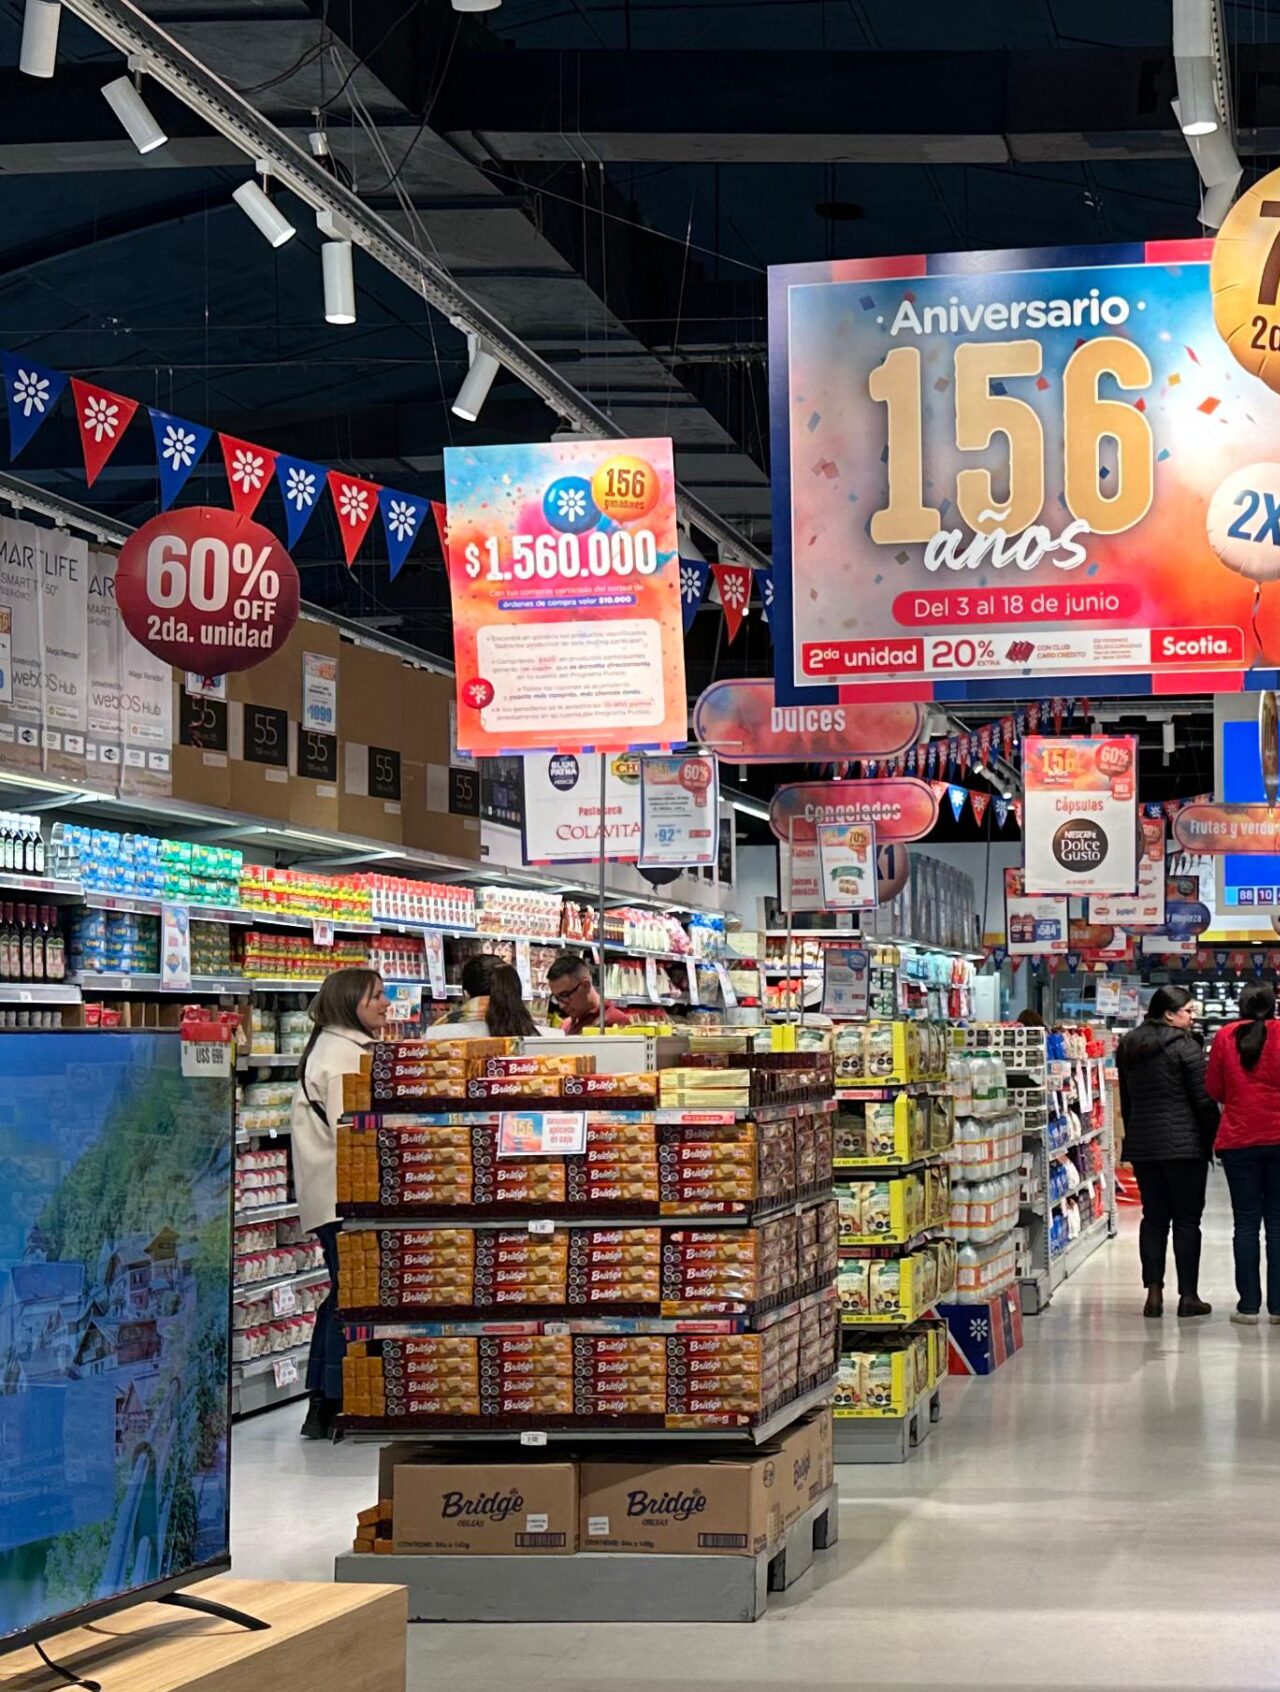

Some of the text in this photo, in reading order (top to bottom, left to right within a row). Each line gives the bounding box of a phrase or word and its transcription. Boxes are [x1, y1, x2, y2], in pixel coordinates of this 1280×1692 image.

[891, 289, 1130, 336] Aniversario
[869, 336, 1153, 545] 156
[605, 468, 646, 498] 156
[604, 500, 645, 511] ganadores
[924, 507, 1093, 572] años
[45, 552, 78, 582] LIFE
[147, 535, 280, 611] 60%
[234, 599, 277, 621] OFF
[536, 599, 545, 607] de
[914, 593, 1119, 618] Del 3 al 18 de junio
[147, 615, 274, 648] 2da. unidad
[809, 645, 917, 668] 2da unidad
[932, 640, 994, 667] 20%
[59, 683, 77, 695] Hub
[92, 693, 161, 716] webOS Hub
[253, 714, 278, 746] 55
[771, 707, 846, 733] Dulces
[307, 734, 327, 763] 55
[1042, 747, 1076, 772] 156
[1101, 746, 1129, 763] 60%
[375, 757, 394, 783] 55
[683, 765, 708, 780] 60%
[805, 802, 901, 822] Congelados
[1056, 796, 1104, 815] Cápsulas
[556, 824, 641, 841] COLAVITA
[1190, 818, 1226, 835] Frutas
[1231, 822, 1238, 838] y
[1061, 840, 1100, 851] Dolce
[1061, 850, 1100, 861] Gusto
[1260, 890, 1272, 899] 10
[398, 1046, 429, 1059] Bridge
[509, 1063, 539, 1075] Bridge
[587, 1079, 617, 1091] Bridge
[442, 1491, 524, 1522] Bridge
[627, 1490, 706, 1521] Bridge
